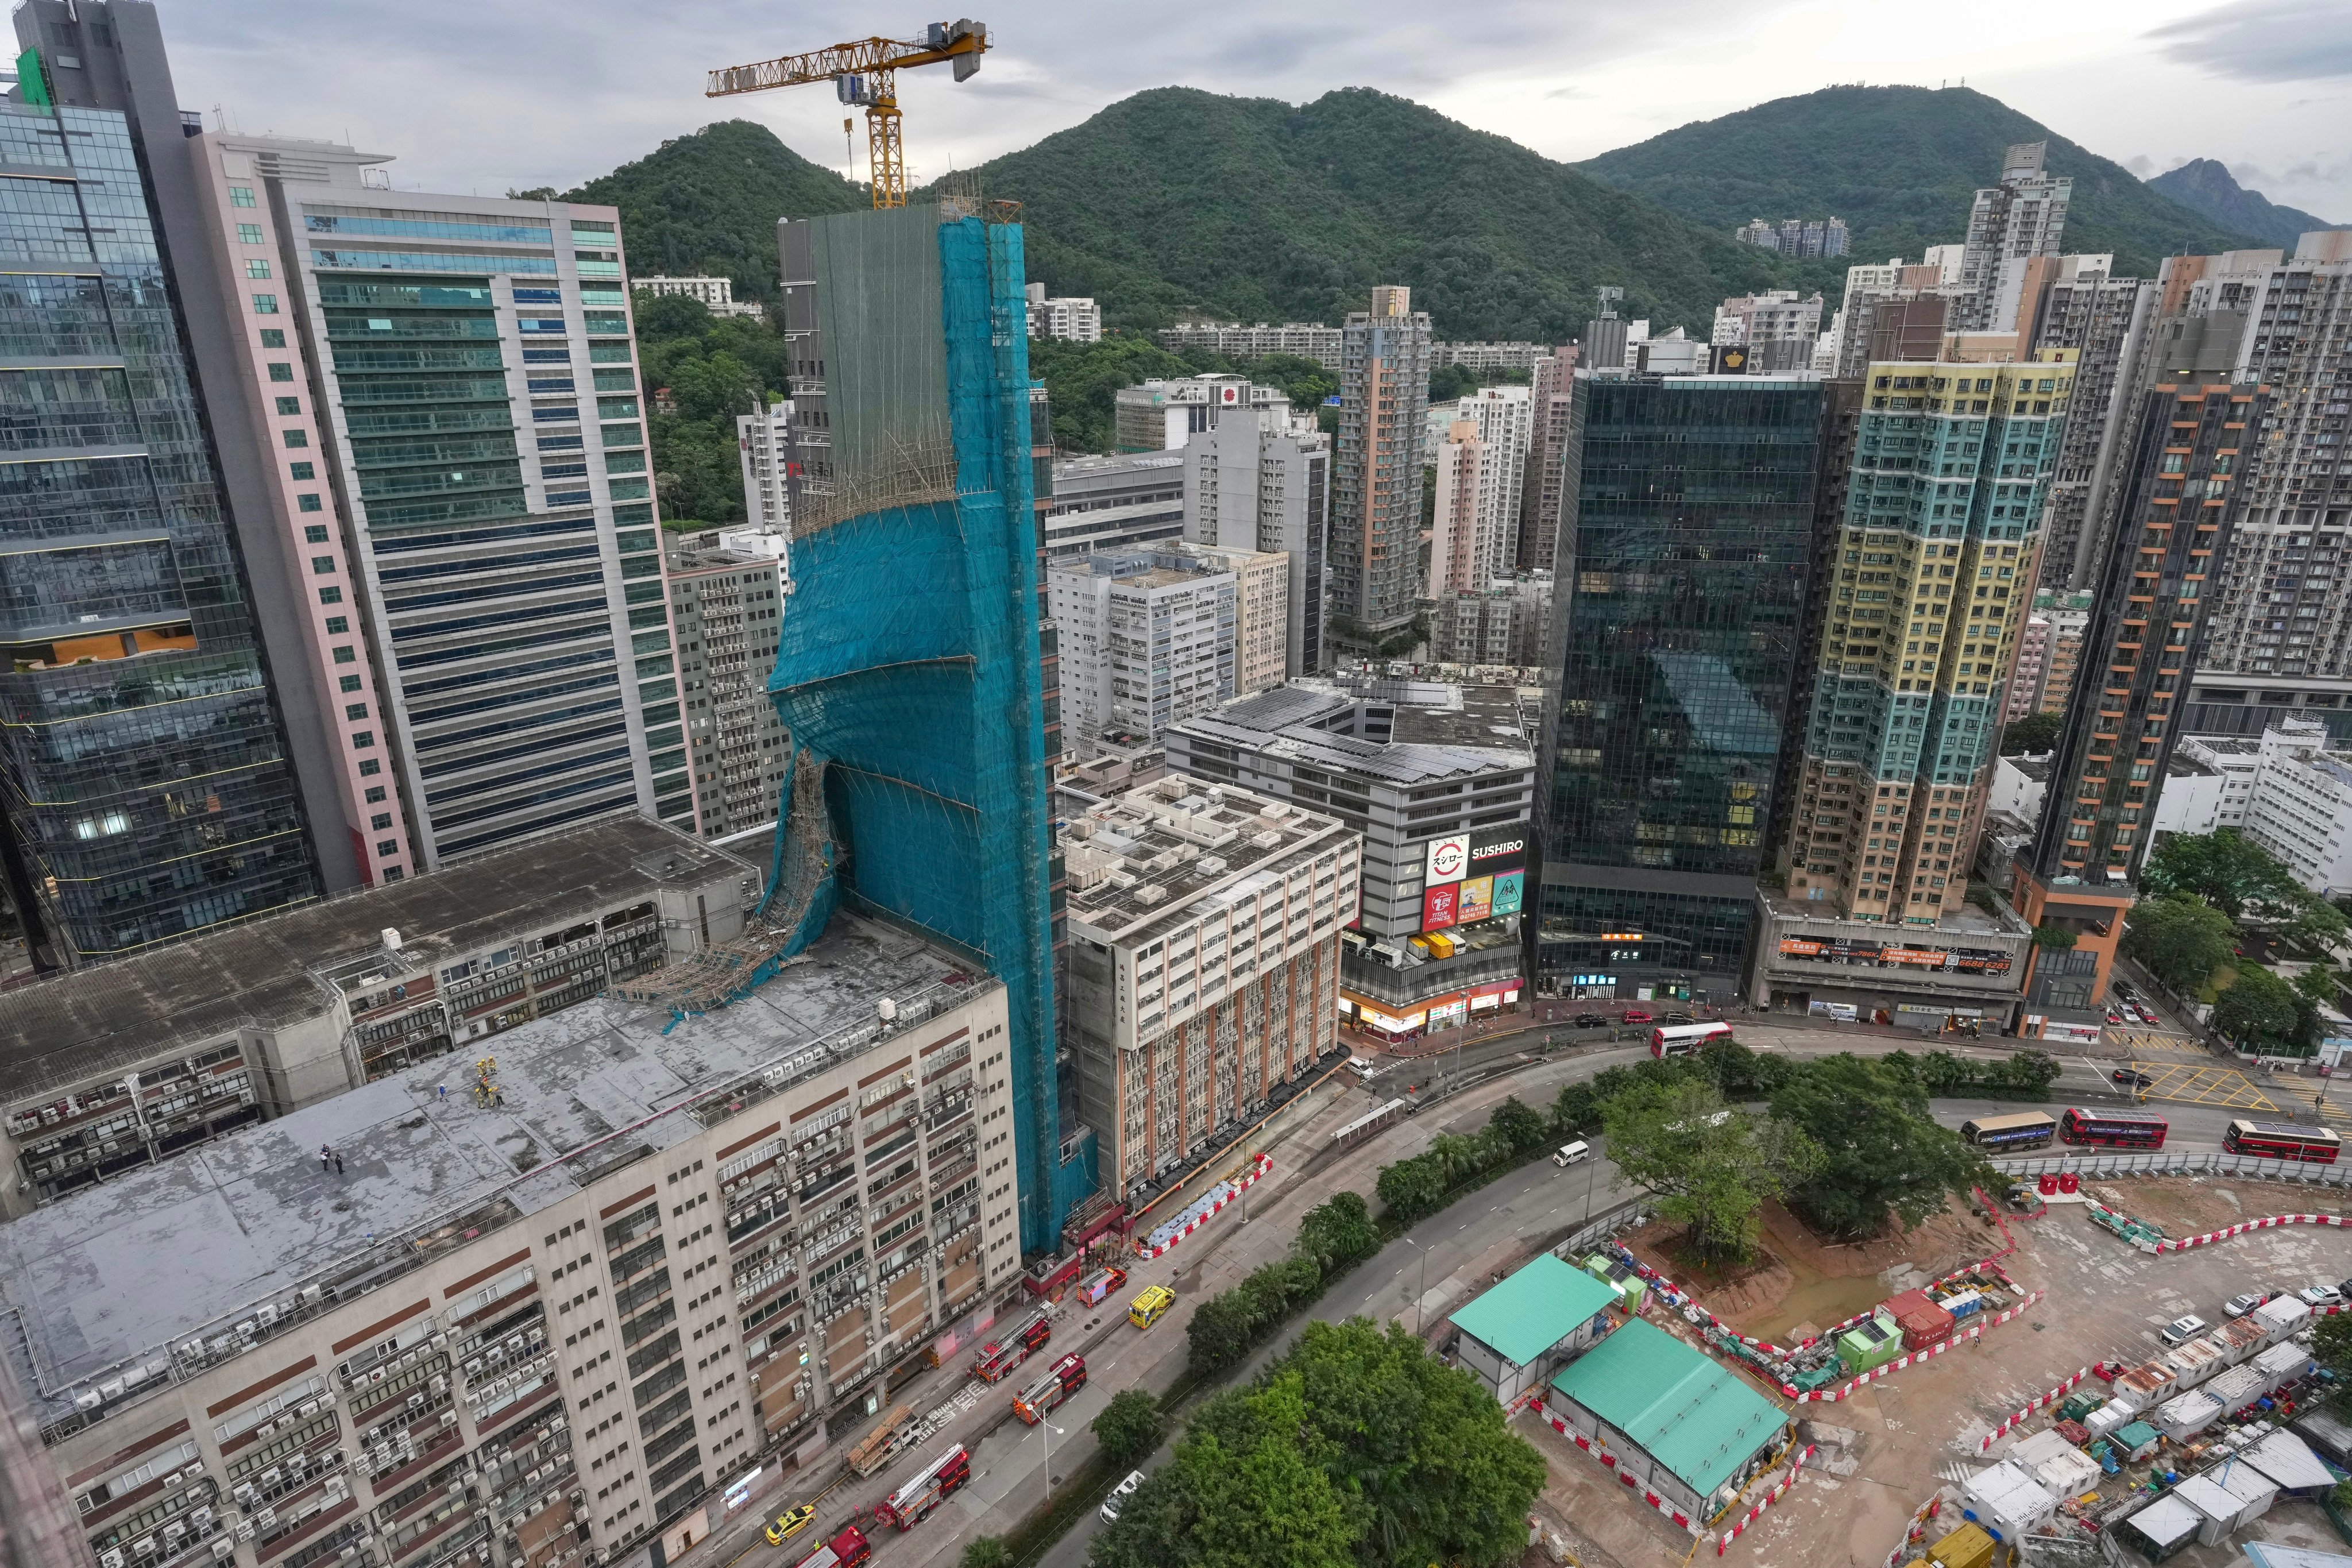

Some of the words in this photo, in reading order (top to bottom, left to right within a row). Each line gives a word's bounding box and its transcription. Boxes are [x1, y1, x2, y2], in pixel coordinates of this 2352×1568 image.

[1472, 840, 1523, 859] SUSHIRO
[1432, 855, 1463, 867] スシロー
[1428, 914, 1451, 924] FITNESS
[1985, 961, 2010, 970] 6283
[965, 1378, 989, 1397] KEEP
[951, 1389, 977, 1412] CLEAR
